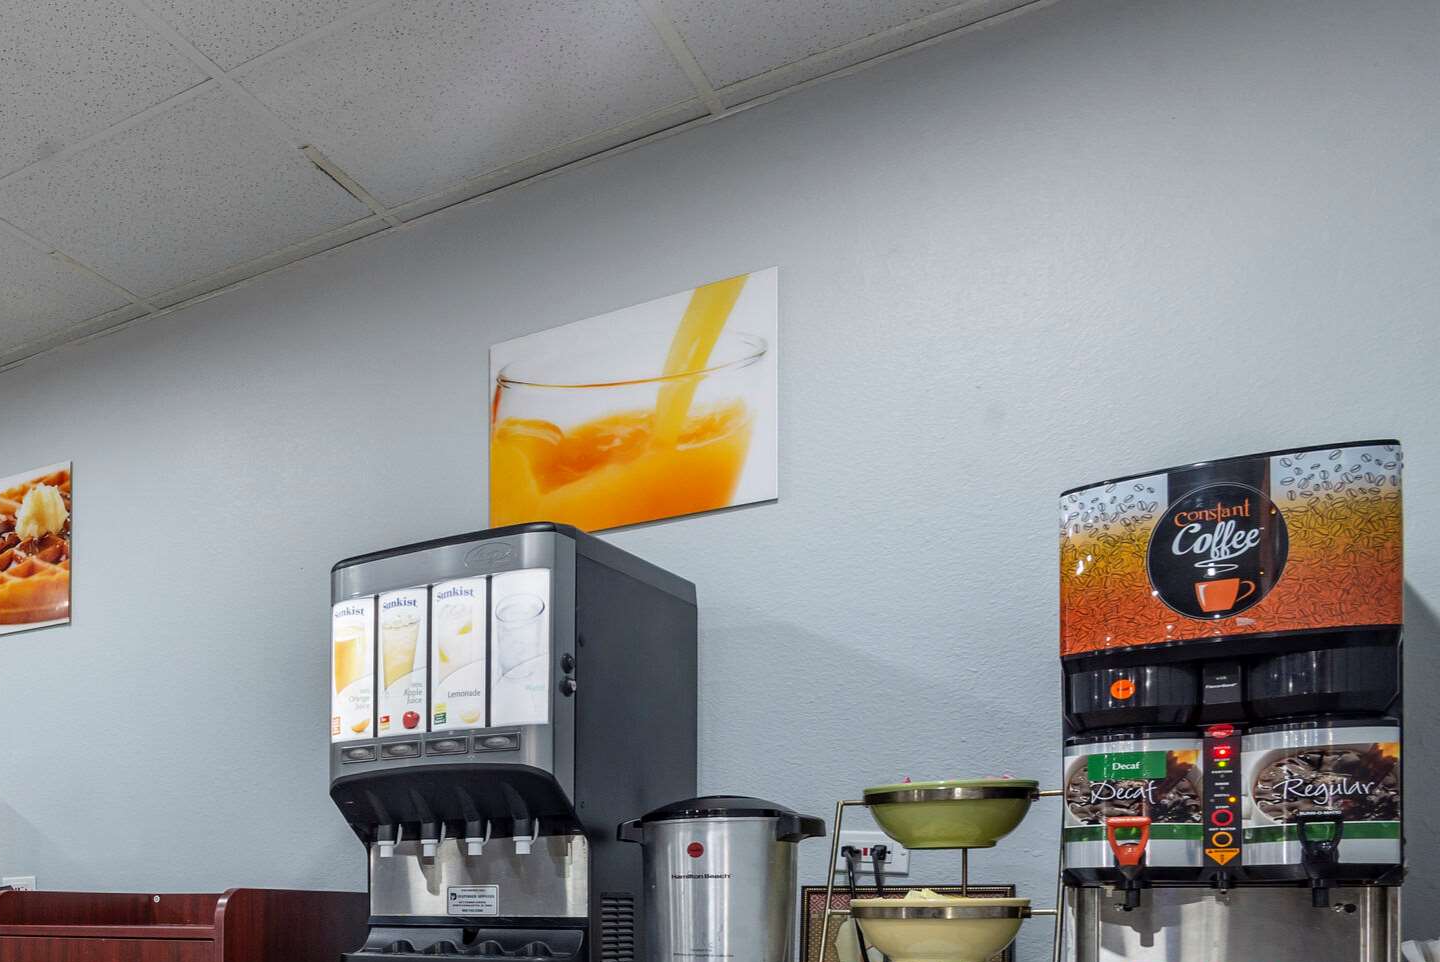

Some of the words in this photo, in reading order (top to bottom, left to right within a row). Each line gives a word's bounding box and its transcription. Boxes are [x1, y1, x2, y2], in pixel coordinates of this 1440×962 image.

[1171, 519, 1261, 561] Coffee
[403, 687, 423, 697] Apple
[447, 687, 481, 698] Lemonade
[1111, 762, 1141, 771] Decaf
[1090, 779, 1158, 805] Decaf
[1272, 777, 1375, 805] Regular
